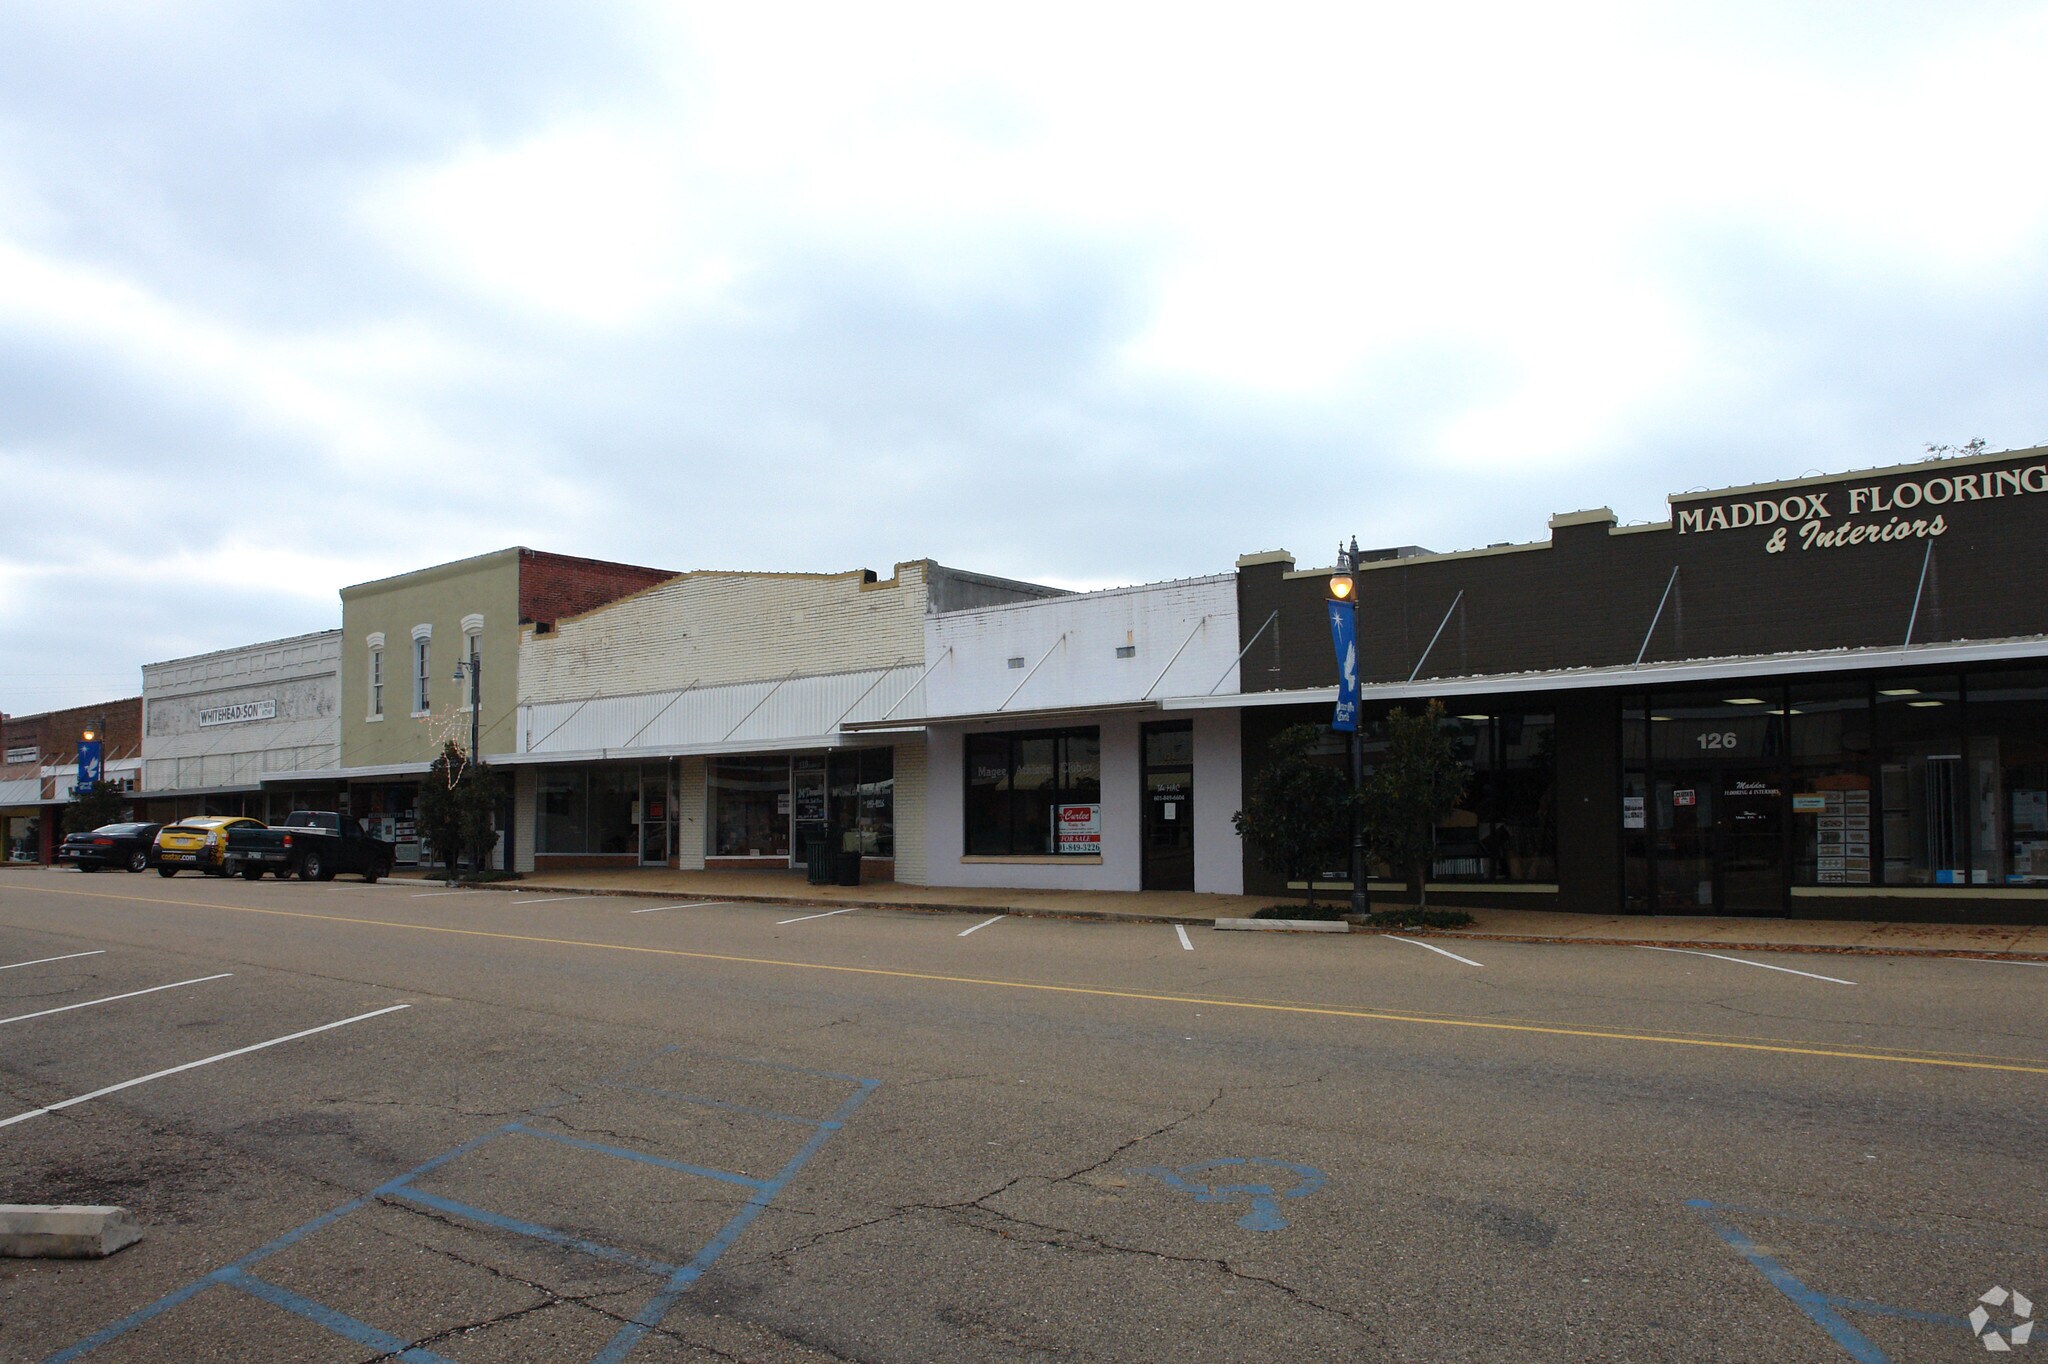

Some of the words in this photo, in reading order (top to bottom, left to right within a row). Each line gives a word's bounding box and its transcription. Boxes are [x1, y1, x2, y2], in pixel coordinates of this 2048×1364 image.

[1678, 492, 1832, 535] MADDOX
[1848, 465, 2048, 514] FLOORING
[1765, 527, 1787, 554] &
[1799, 514, 1947, 551] Interiors
[1697, 732, 1737, 749] 126
[978, 766, 1006, 778] Magee
[1064, 809, 1090, 821] Curlee
[161, 852, 197, 862] costar.com
